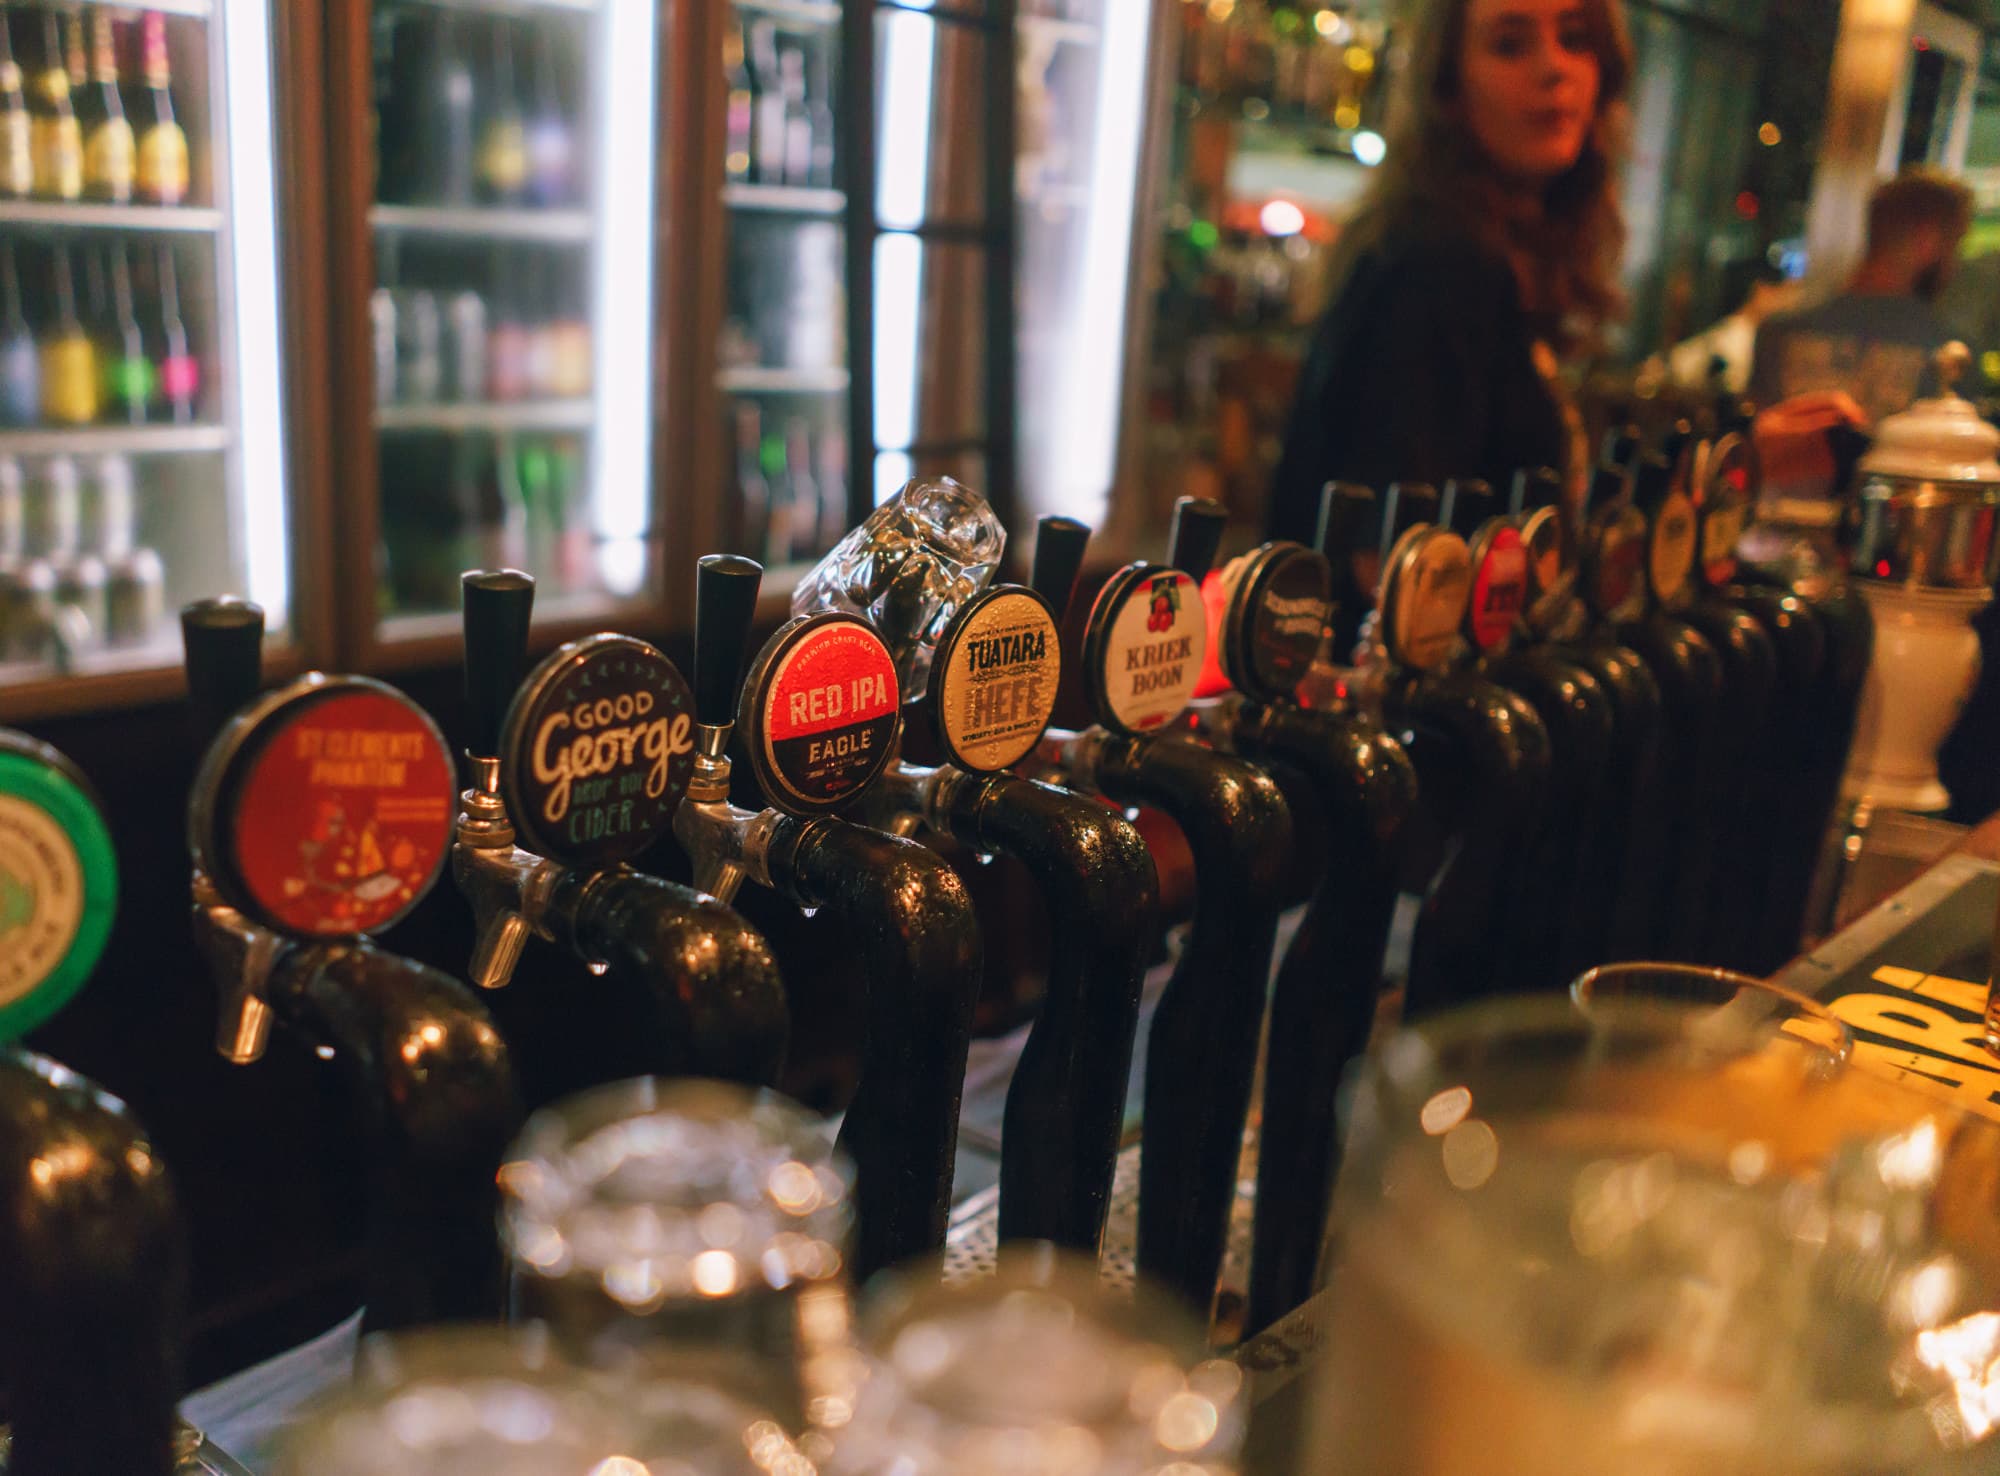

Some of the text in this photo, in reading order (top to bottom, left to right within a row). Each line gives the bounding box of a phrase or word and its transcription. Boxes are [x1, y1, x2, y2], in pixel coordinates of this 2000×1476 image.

[968, 630, 1046, 672] TUATARA
[1125, 636, 1192, 671] KRIEK
[789, 673, 888, 726] RED IPA
[1132, 665, 1183, 697] BOON
[573, 691, 654, 730] GOOD
[974, 676, 1043, 730] HEFE
[532, 713, 693, 822] George
[808, 731, 872, 764] EAGLE
[569, 801, 635, 843] CIDER
